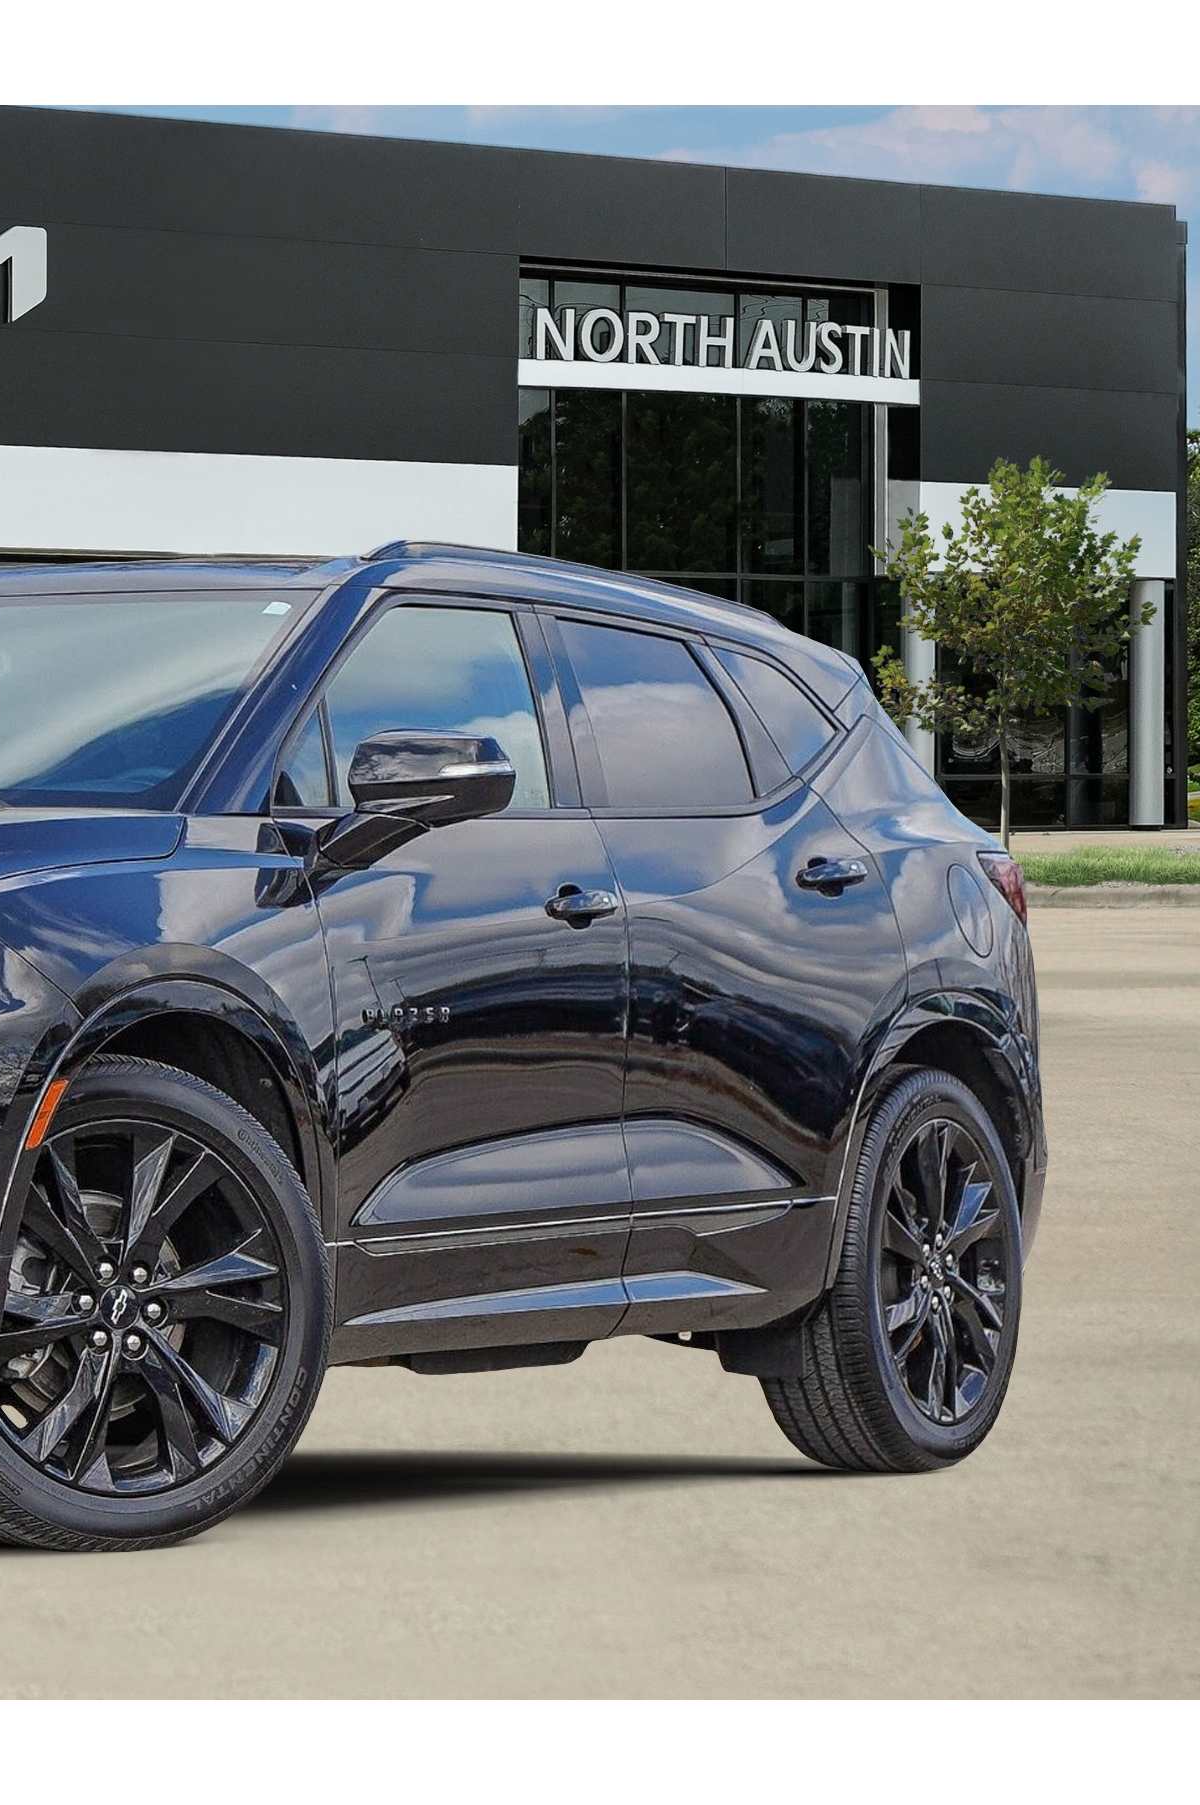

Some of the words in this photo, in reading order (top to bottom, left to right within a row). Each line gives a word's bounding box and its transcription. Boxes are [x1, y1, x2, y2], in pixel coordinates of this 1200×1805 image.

[535, 307, 734, 368] NORTH
[746, 318, 911, 379] AUSTIN
[187, 1365, 307, 1511] CONTINENTAL
